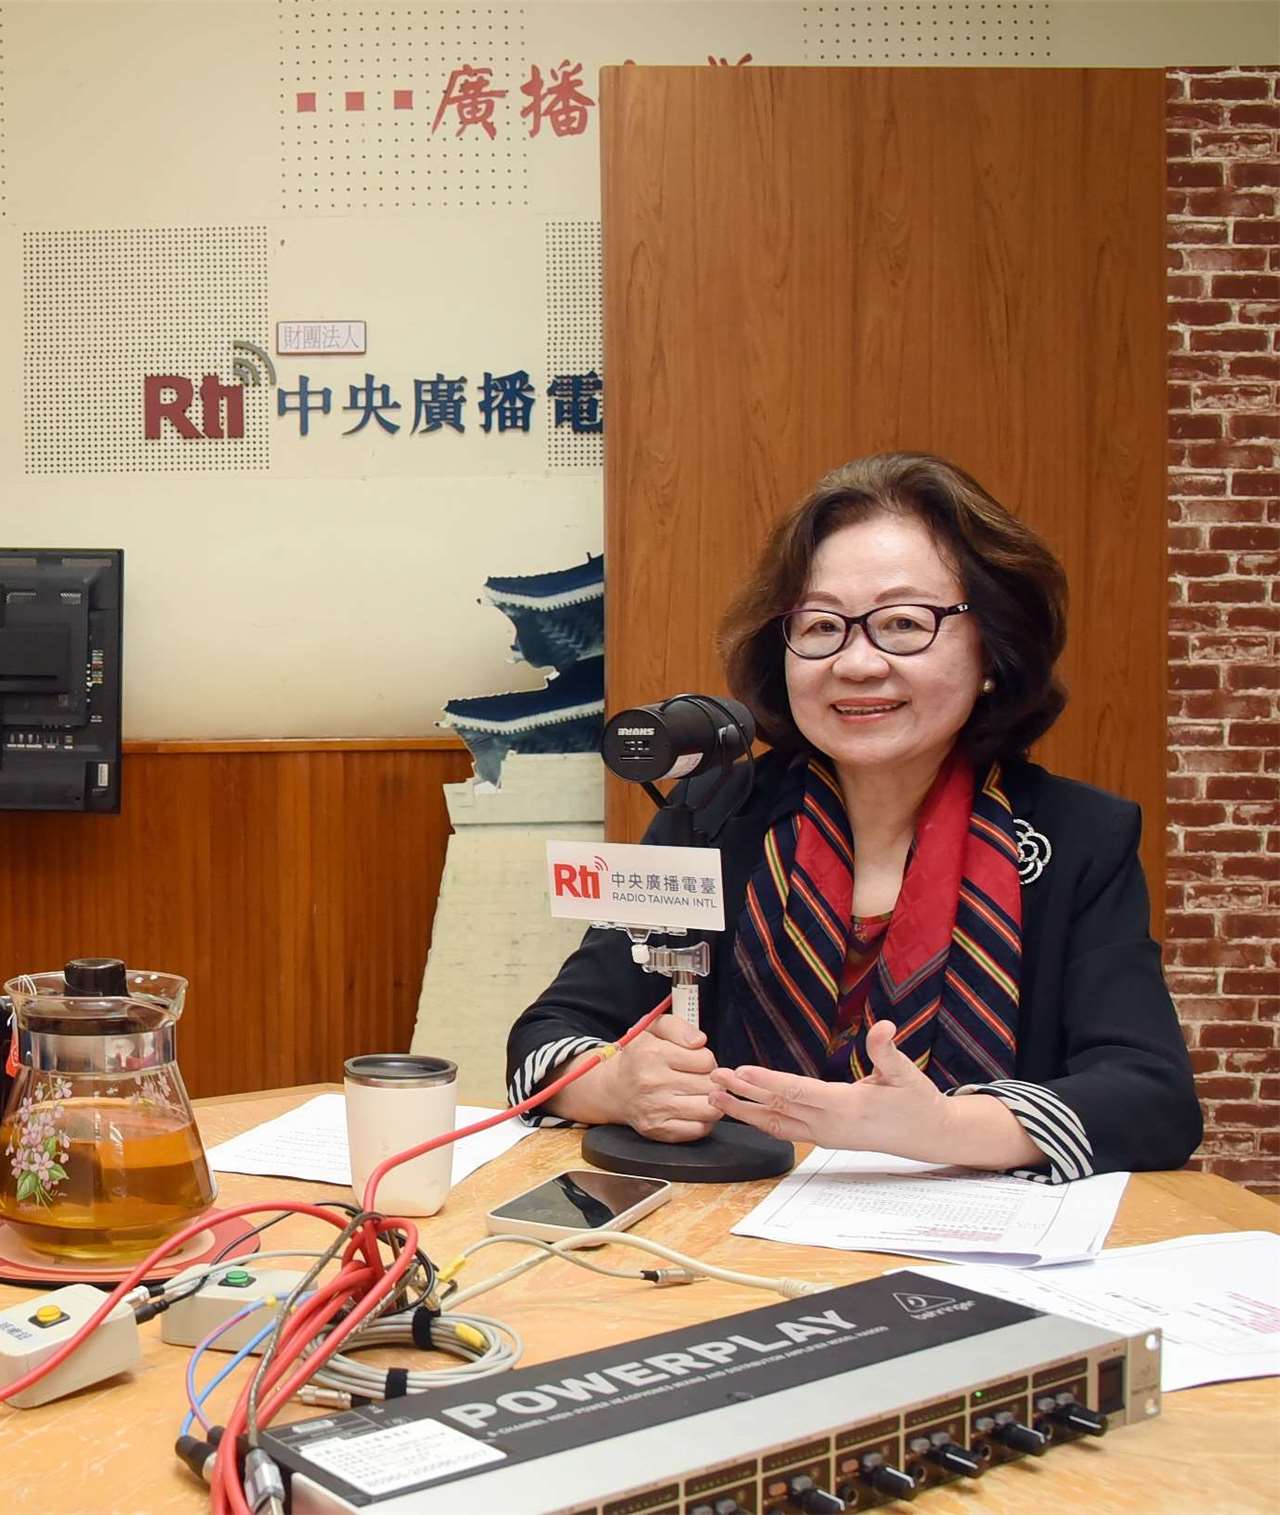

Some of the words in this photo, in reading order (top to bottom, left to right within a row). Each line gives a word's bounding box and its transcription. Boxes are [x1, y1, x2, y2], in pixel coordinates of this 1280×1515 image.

[283, 325, 360, 350] 財團法人
[277, 370, 603, 438] 中央廣播電
[553, 863, 601, 899] Rti
[611, 871, 717, 895] 中央廣播電臺
[612, 892, 646, 903] RADIO
[649, 894, 690, 907] TAIWAN
[692, 899, 718, 908] INTL
[440, 1309, 858, 1430] POWERPLAY
